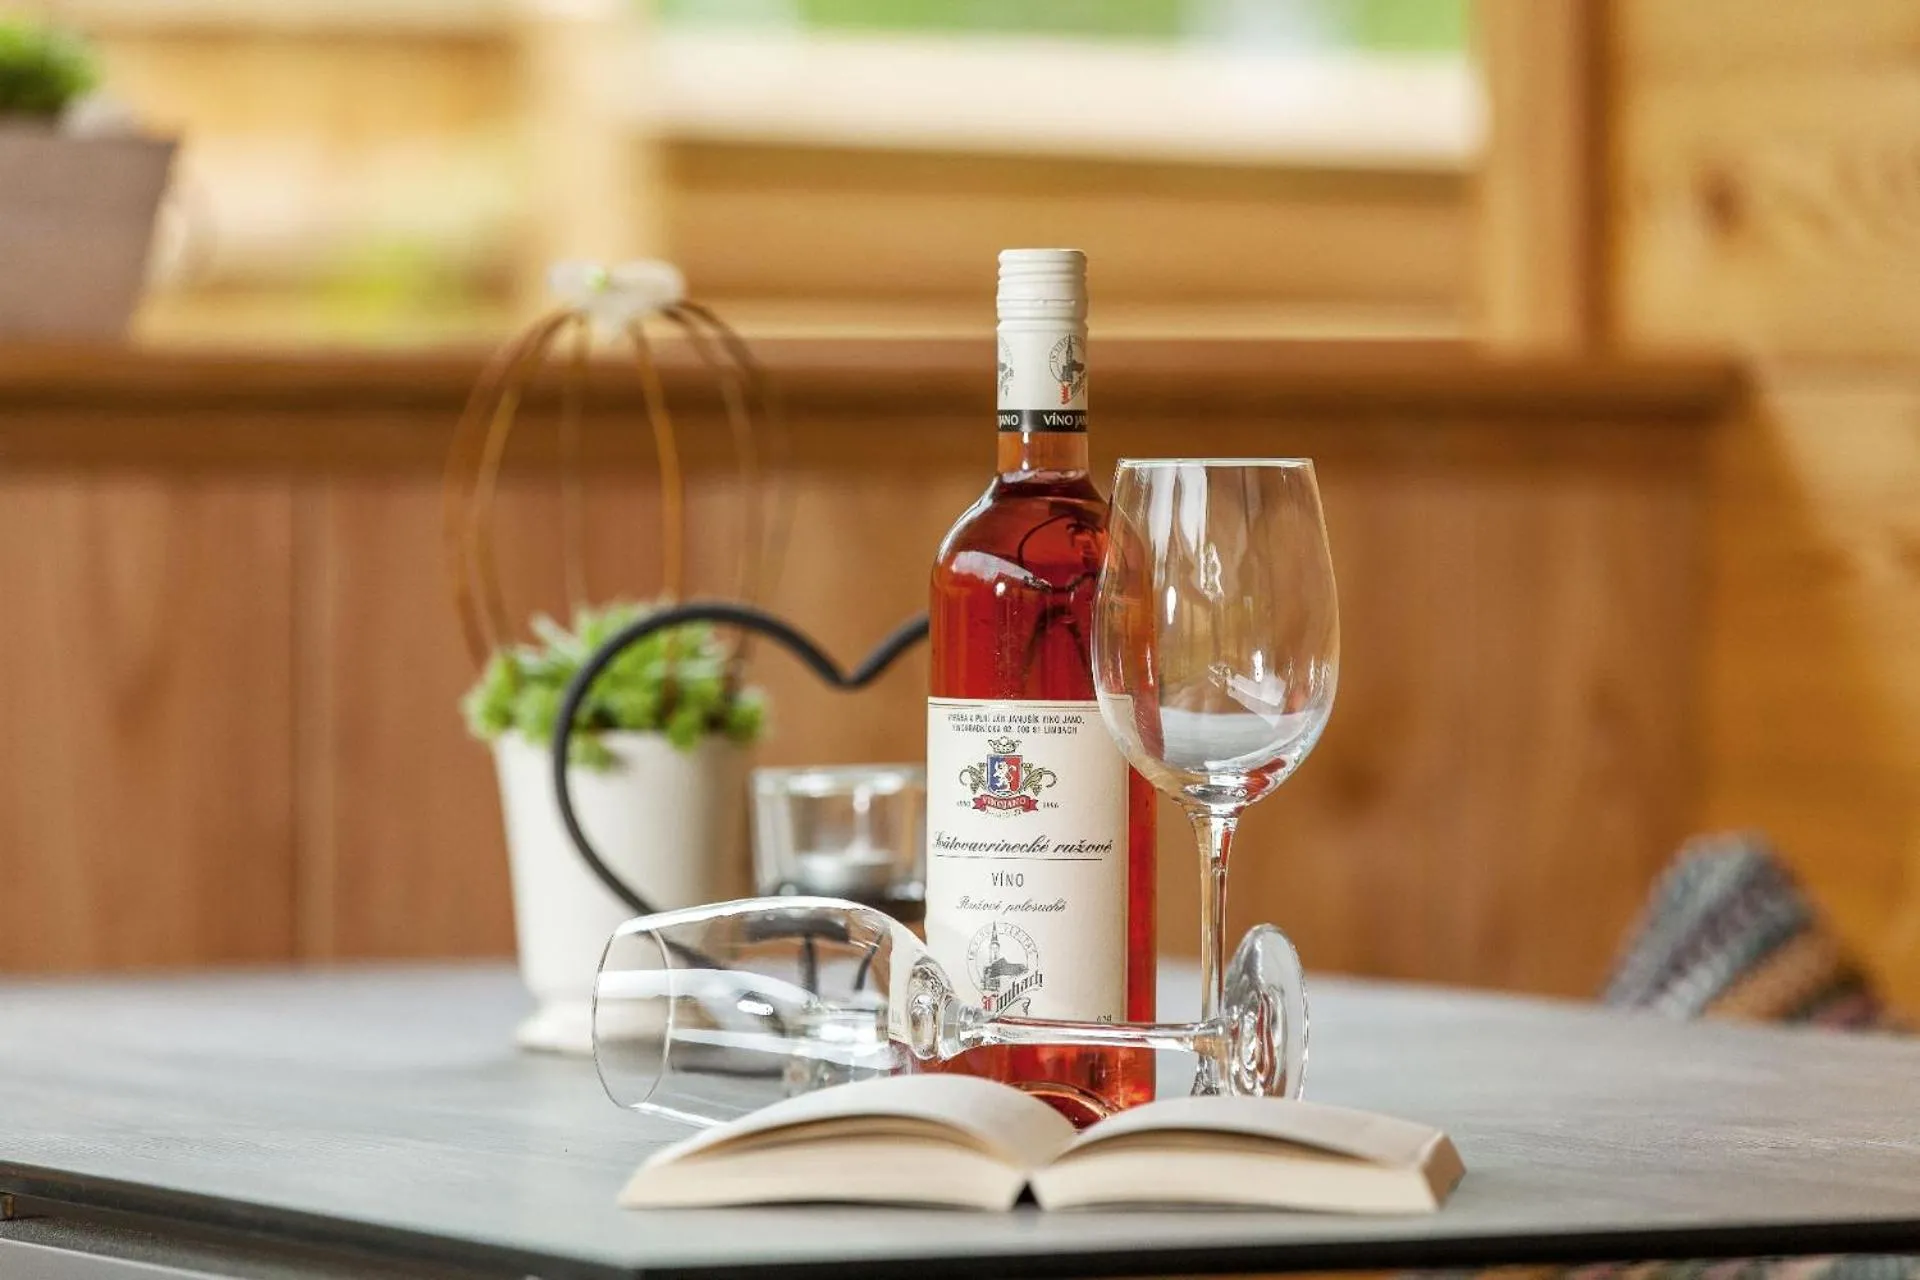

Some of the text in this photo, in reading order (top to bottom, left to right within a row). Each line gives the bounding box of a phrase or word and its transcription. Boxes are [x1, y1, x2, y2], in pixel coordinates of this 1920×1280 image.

[1043, 411, 1074, 426] VÍNO
[1051, 839, 1114, 855] ružové
[990, 870, 1025, 888] VÍNO
